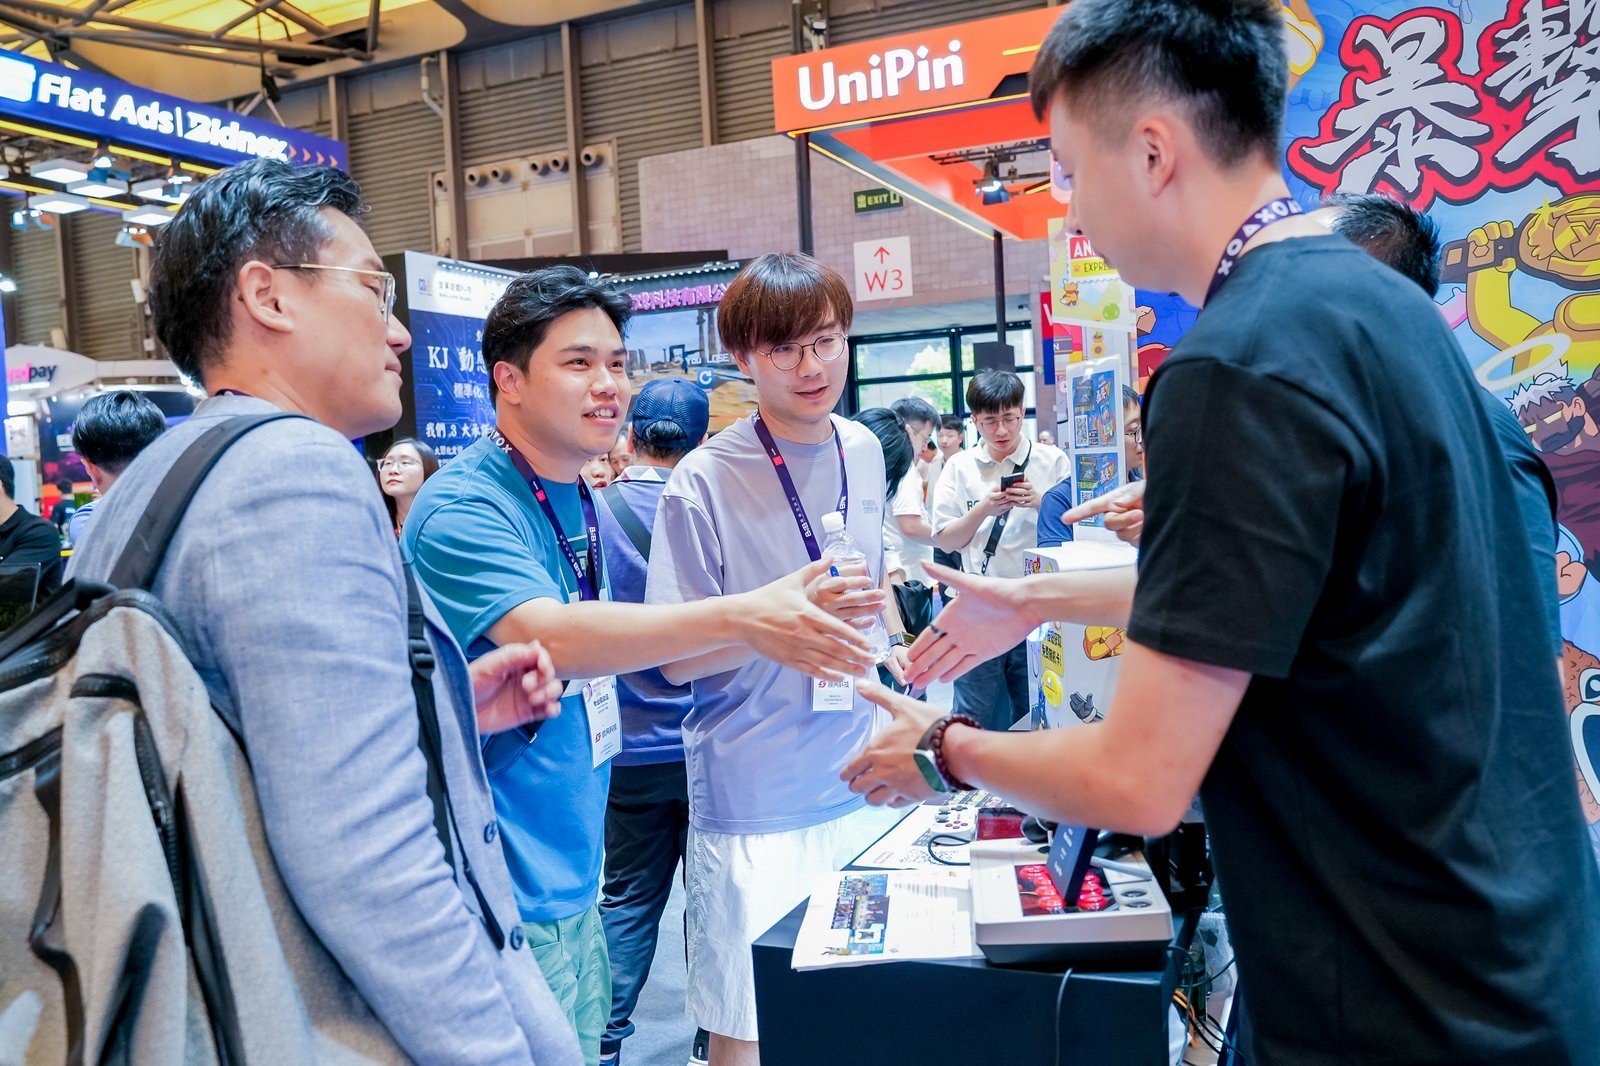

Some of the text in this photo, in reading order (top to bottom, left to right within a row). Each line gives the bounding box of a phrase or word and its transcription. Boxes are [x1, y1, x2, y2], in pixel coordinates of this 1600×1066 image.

[798, 39, 964, 111] UniPin
[37, 73, 107, 117] Flat
[110, 95, 174, 134] Ads
[867, 194, 889, 206] EXIT
[1073, 239, 1096, 258] AN
[1083, 261, 1115, 273] EXPRE
[864, 268, 904, 294] W3
[427, 346, 449, 369] KJ
[685, 353, 730, 366] YOU LOSE
[966, 500, 980, 511] R
